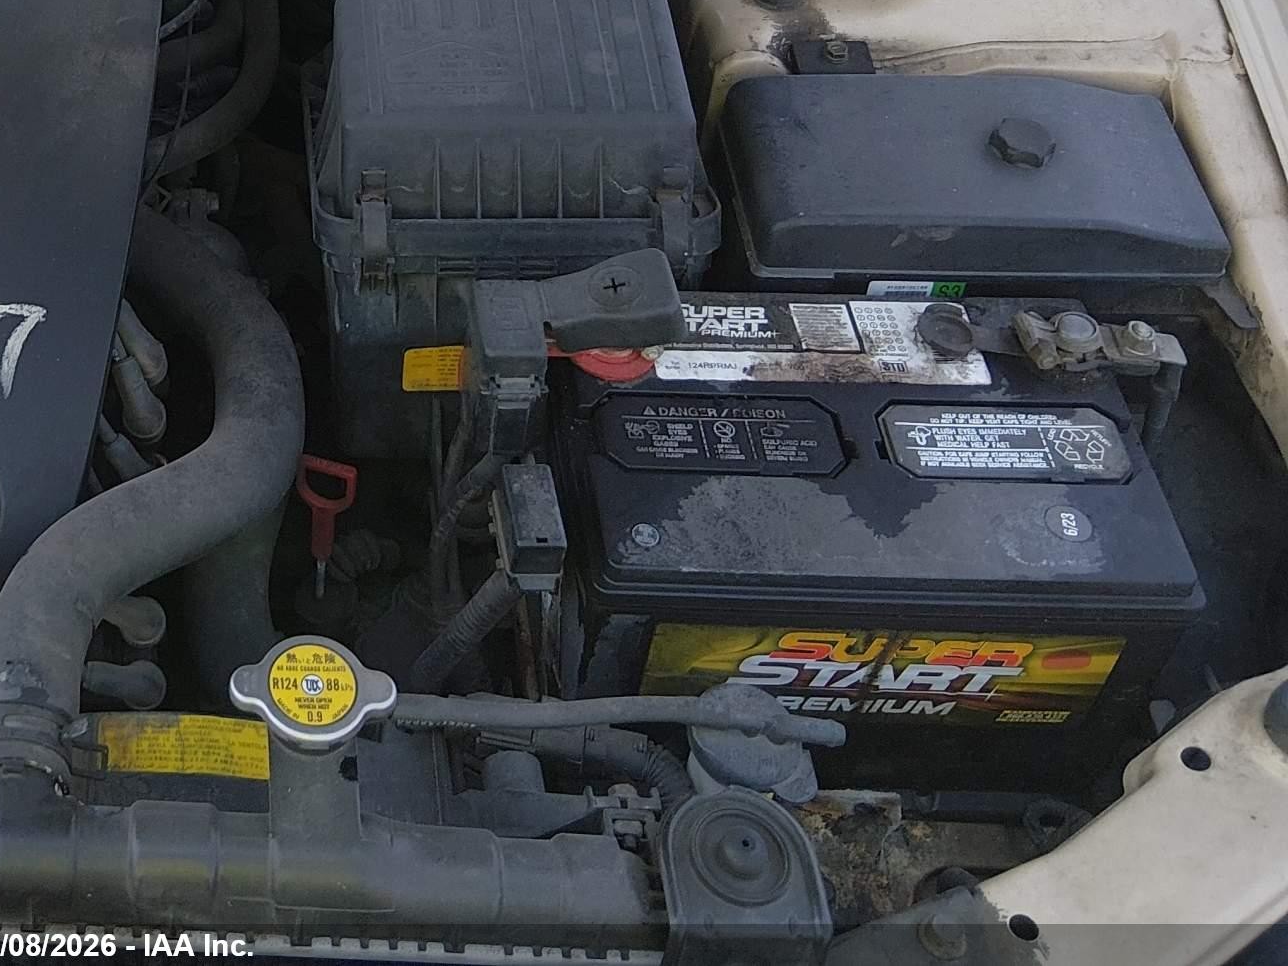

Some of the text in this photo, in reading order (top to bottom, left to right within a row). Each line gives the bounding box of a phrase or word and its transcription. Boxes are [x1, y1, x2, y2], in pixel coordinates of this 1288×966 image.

[685, 318, 769, 332] TART
[658, 407, 717, 418] DANGER
[932, 427, 956, 435] FLUSH
[979, 428, 1027, 436] IMMEDIATELY
[1060, 513, 1079, 536] 6/23
[769, 631, 1033, 668] SUPER
[727, 654, 1025, 694] START
[272, 677, 298, 690] R124
[326, 678, 340, 691] 88
[776, 695, 957, 716] REMIUM
[307, 711, 323, 723] 0.9
